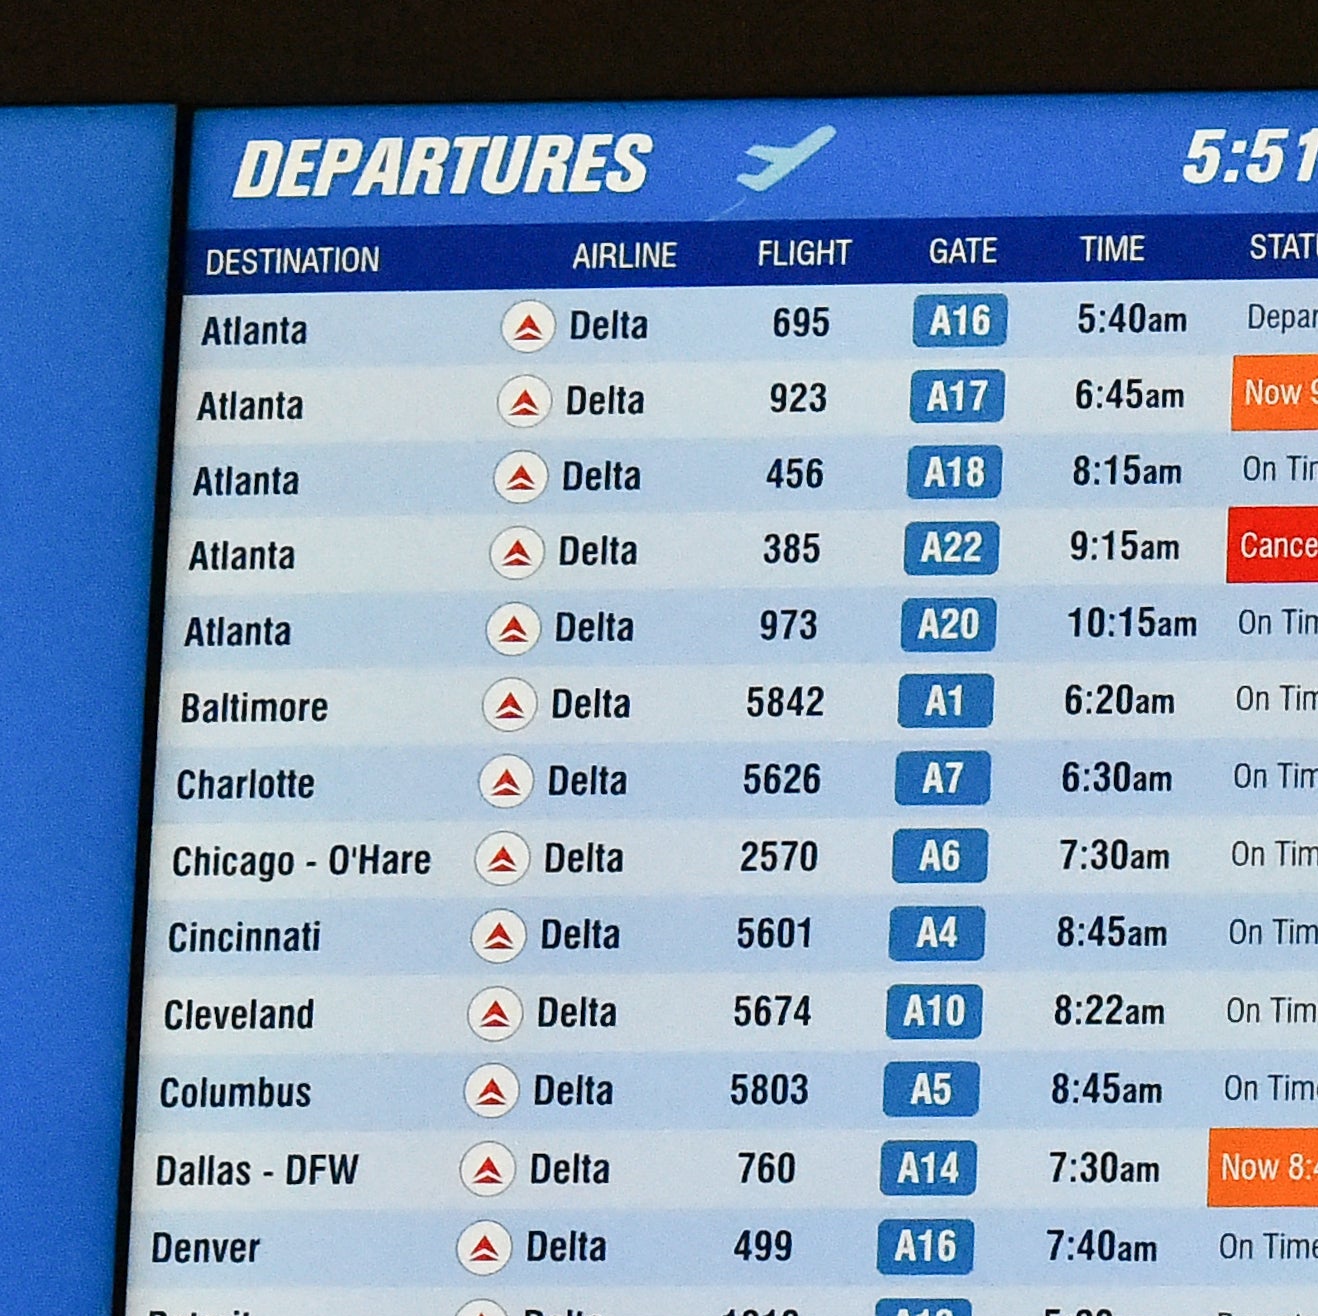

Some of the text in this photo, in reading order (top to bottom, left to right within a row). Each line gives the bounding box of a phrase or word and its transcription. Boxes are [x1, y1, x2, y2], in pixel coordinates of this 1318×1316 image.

[231, 132, 654, 199] DEPARTURES
[205, 245, 380, 276] DESTINATION
[571, 241, 678, 270] AIRLINE
[757, 238, 854, 267] FLIGHT
[928, 236, 998, 265] GATE
[1079, 234, 1146, 263] TIME
[196, 390, 304, 421] Atlanta
[566, 384, 645, 416] Delta
[770, 382, 827, 413] 923
[926, 379, 989, 412] A17
[1075, 378, 1185, 410] 6:45am
[1245, 378, 1303, 406] Now
[164, 998, 314, 1031] Cleveland
[537, 995, 617, 1028] Delta
[733, 994, 812, 1027] 5674
[902, 993, 966, 1027] A10
[1054, 993, 1165, 1026] 8:22am
[1227, 996, 1260, 1024] On
[156, 1154, 251, 1187] Dallas
[286, 1153, 360, 1186] DFW
[530, 1152, 610, 1185] Delta
[738, 1151, 796, 1184] 760
[896, 1150, 960, 1184] A14
[1049, 1151, 1160, 1184] 7:30am
[1221, 1152, 1280, 1181] Now
